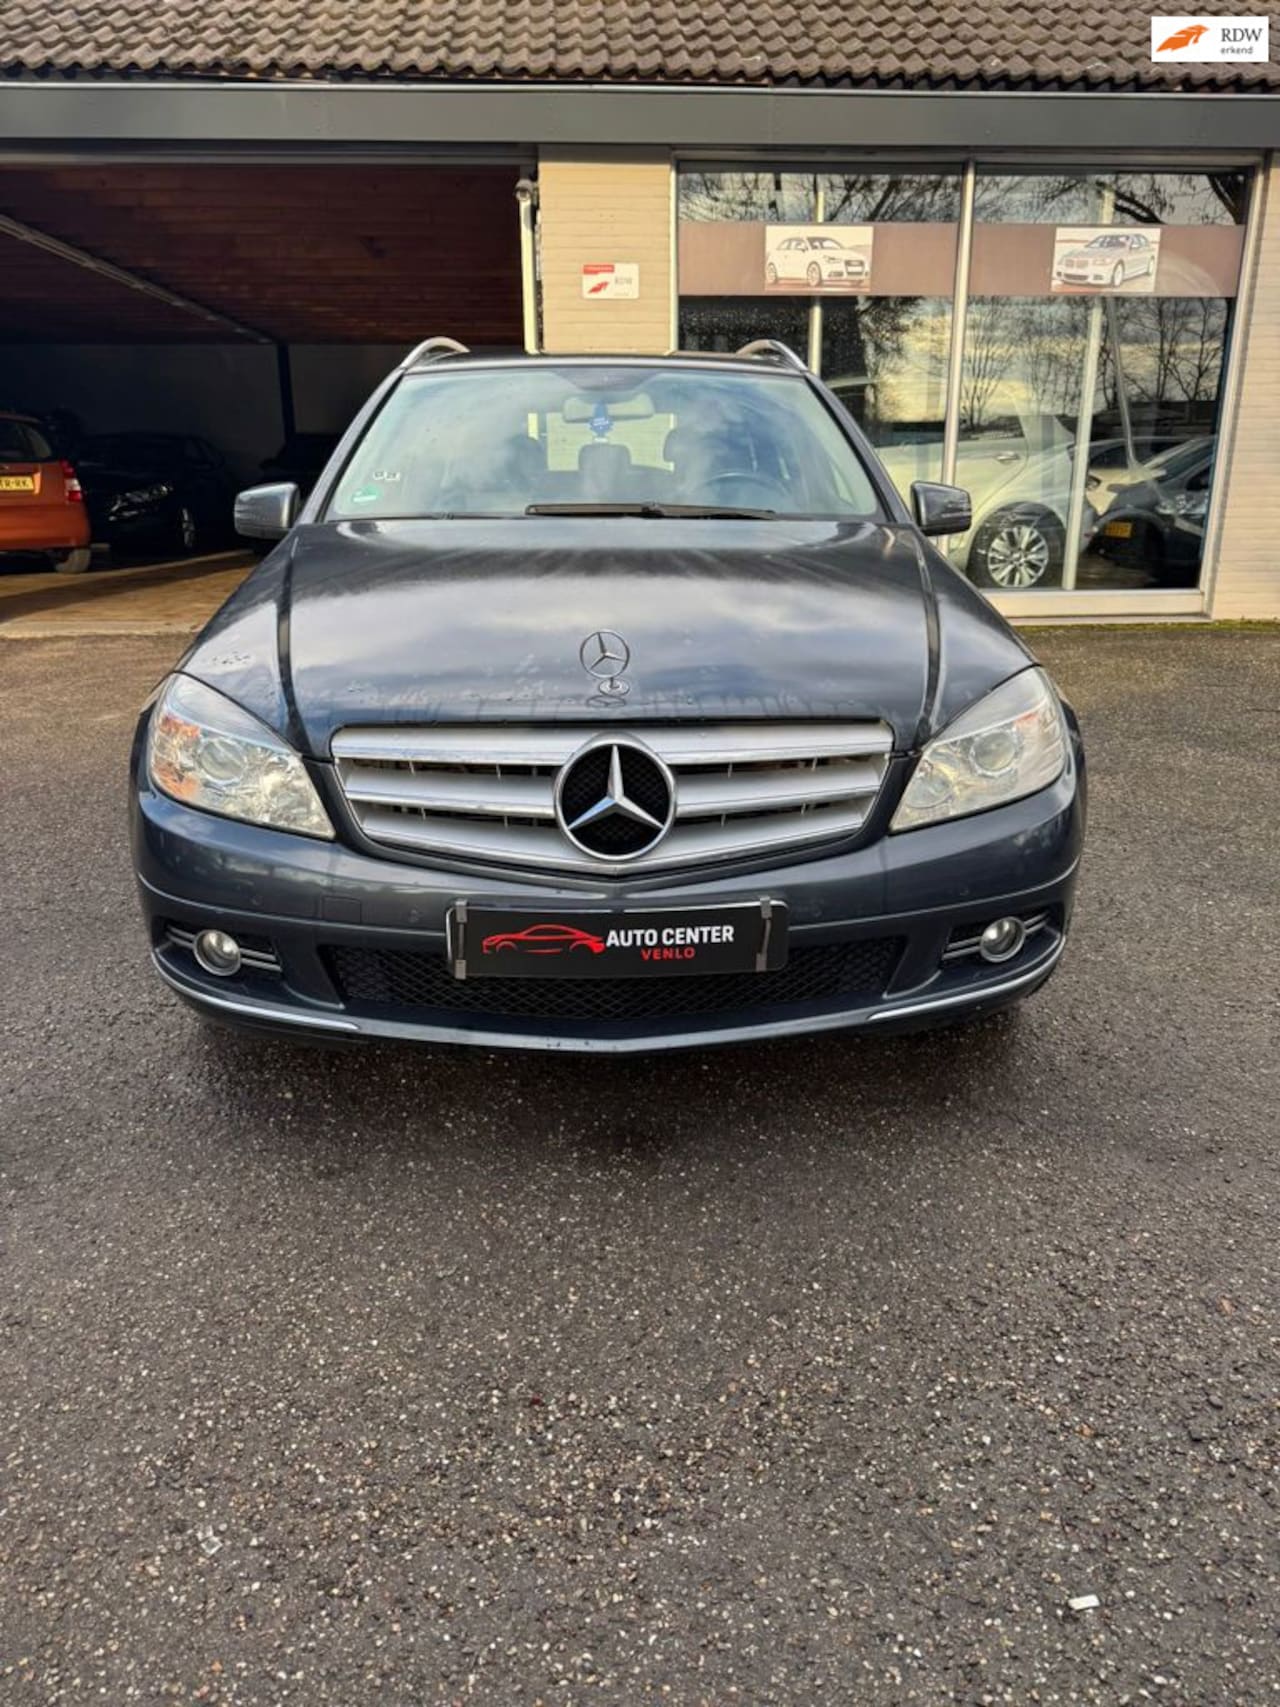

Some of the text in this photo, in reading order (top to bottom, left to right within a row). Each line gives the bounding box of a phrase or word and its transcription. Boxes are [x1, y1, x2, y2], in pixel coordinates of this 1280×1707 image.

[606, 925, 734, 947] AUTO CENTER
[641, 946, 695, 961] VENLO
